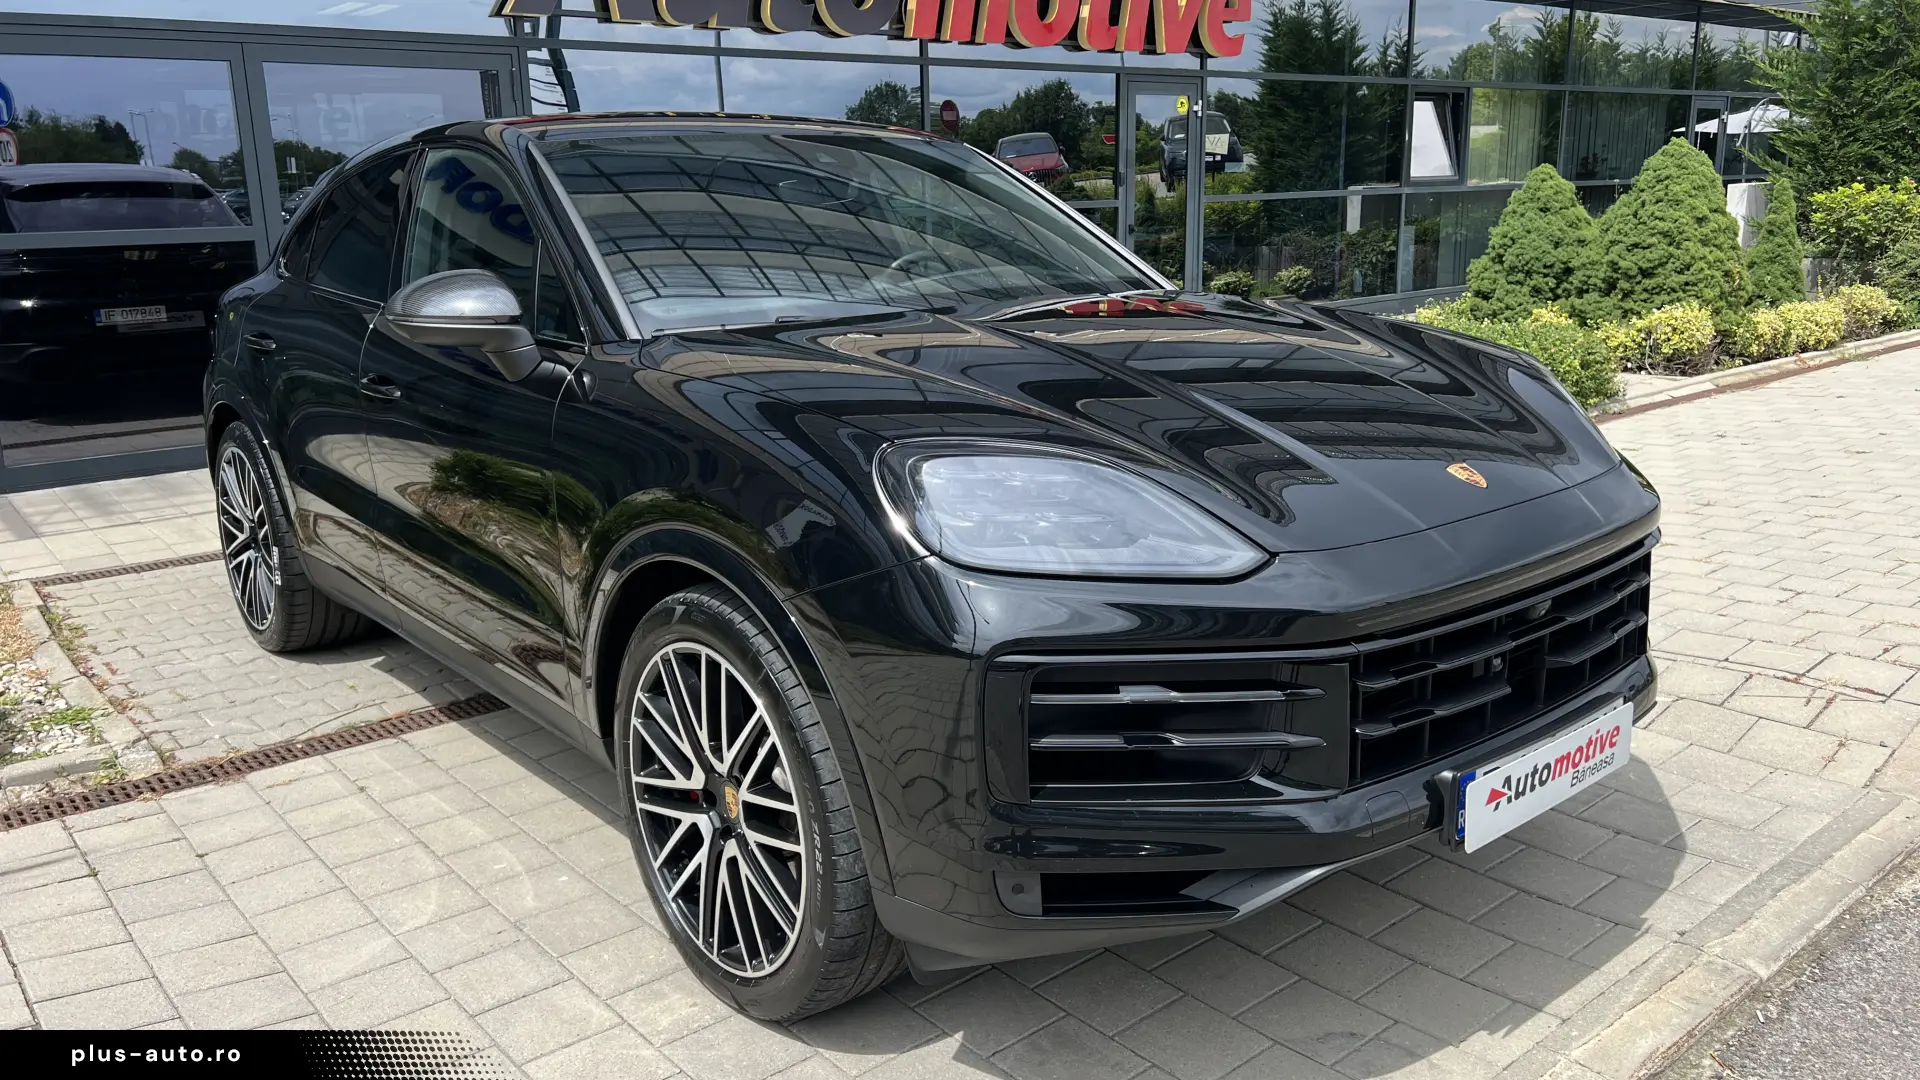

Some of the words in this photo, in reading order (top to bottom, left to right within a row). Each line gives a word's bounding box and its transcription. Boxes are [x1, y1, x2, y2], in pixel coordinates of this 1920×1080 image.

[104, 310, 116, 321] IF
[121, 307, 162, 320] 017848
[1493, 725, 1620, 812] Automotive
